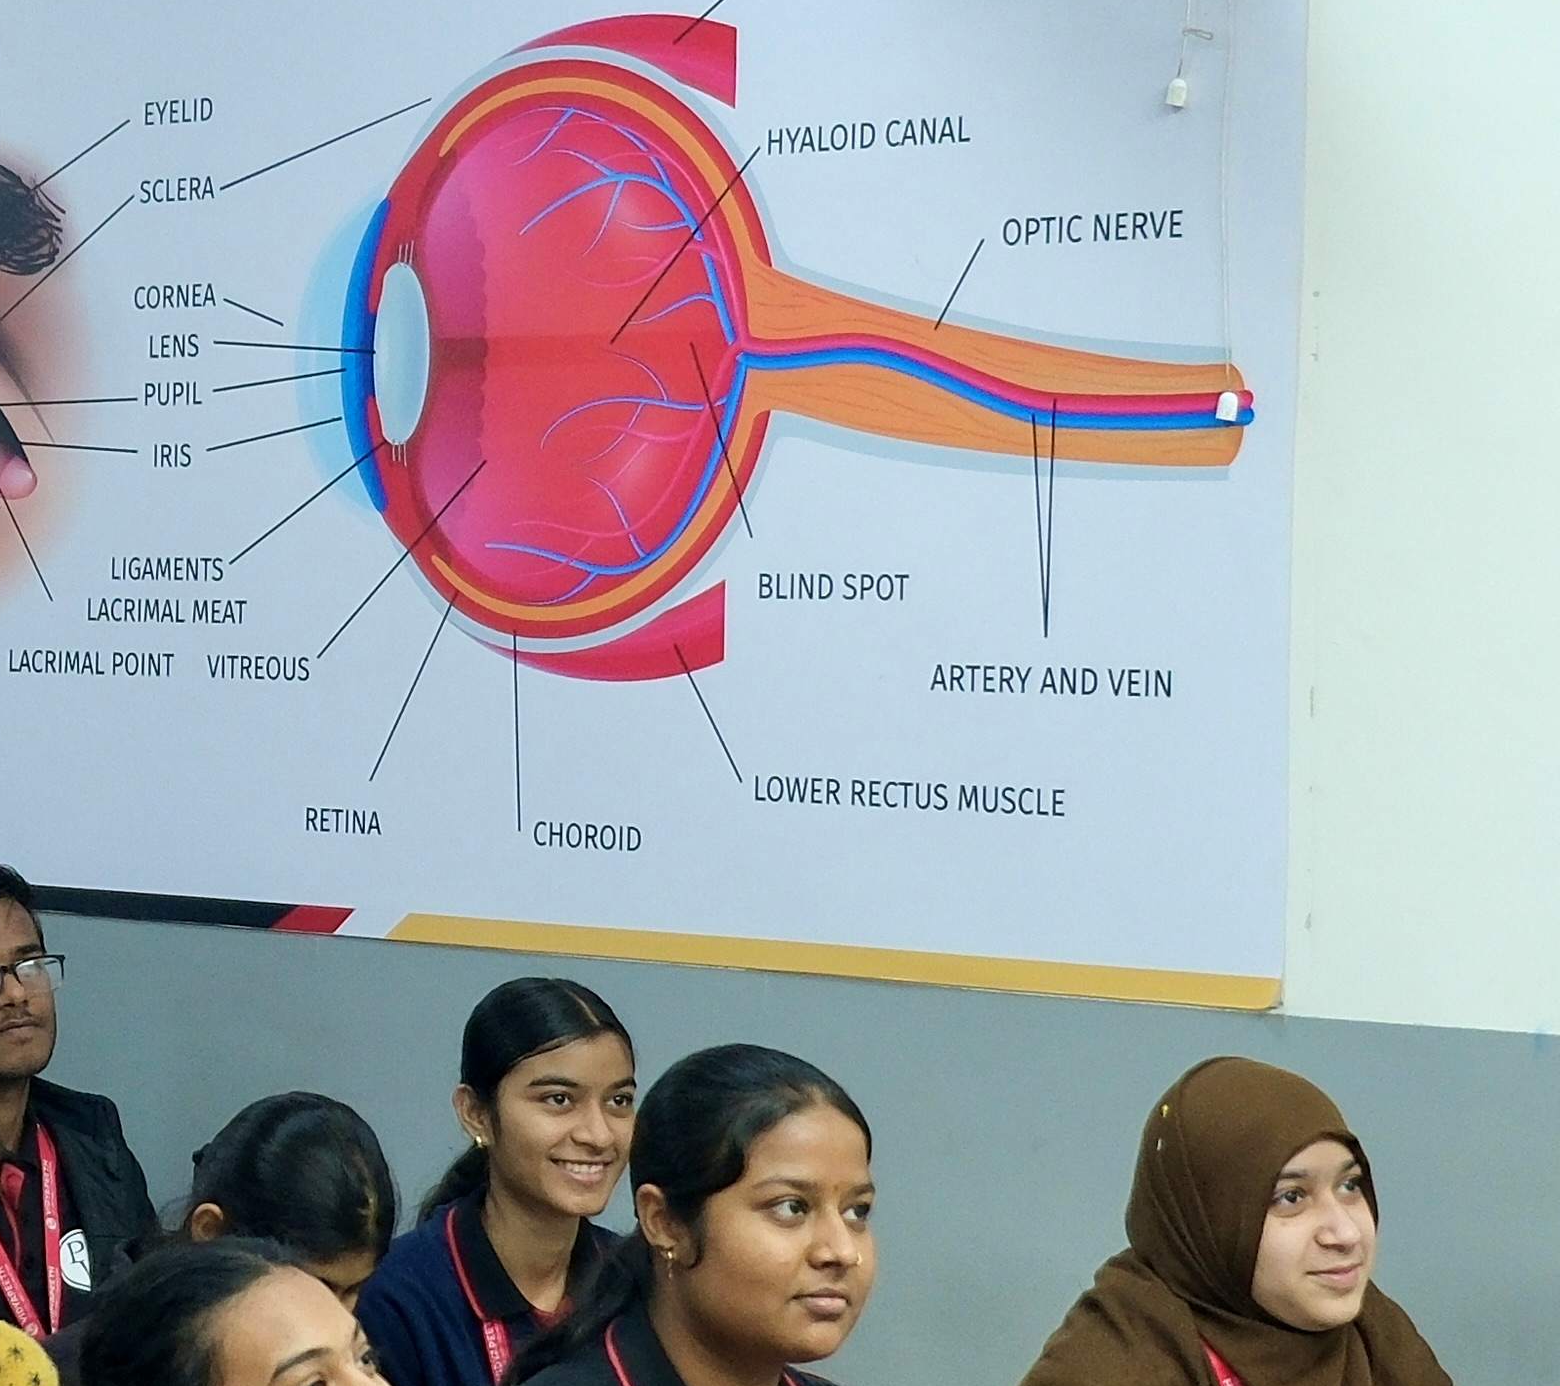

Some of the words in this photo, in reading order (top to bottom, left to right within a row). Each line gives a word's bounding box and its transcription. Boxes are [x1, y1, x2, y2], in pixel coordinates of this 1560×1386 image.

[144, 97, 213, 126] EYELID
[767, 122, 876, 156] HYALOID
[885, 116, 971, 148] CANAL
[139, 175, 215, 204] SCLERA
[1003, 214, 1083, 246] OPTIC
[1093, 209, 1184, 242] NERVE
[134, 283, 217, 310] CORNEA
[149, 333, 199, 359] LENS
[144, 381, 203, 406] PUPIL
[153, 443, 192, 468] IRIS
[111, 556, 224, 582] LIGAMENTS
[759, 573, 834, 600] BLIND
[842, 573, 910, 601] SPOT
[87, 597, 186, 623] LACRIMAL
[192, 599, 248, 625] MEAT
[9, 649, 105, 675] LACRIMAL
[112, 651, 175, 677] POINT
[206, 654, 310, 682] VITREOUS
[930, 664, 1032, 694] ARTERY
[1039, 667, 1098, 696] AND
[1108, 668, 1172, 698] VEIN
[754, 775, 841, 805] LOWER
[851, 779, 949, 811] RECTUS
[958, 784, 1065, 817] MUSCLE
[305, 807, 382, 835] RETINA
[533, 820, 642, 852] CHOROID
